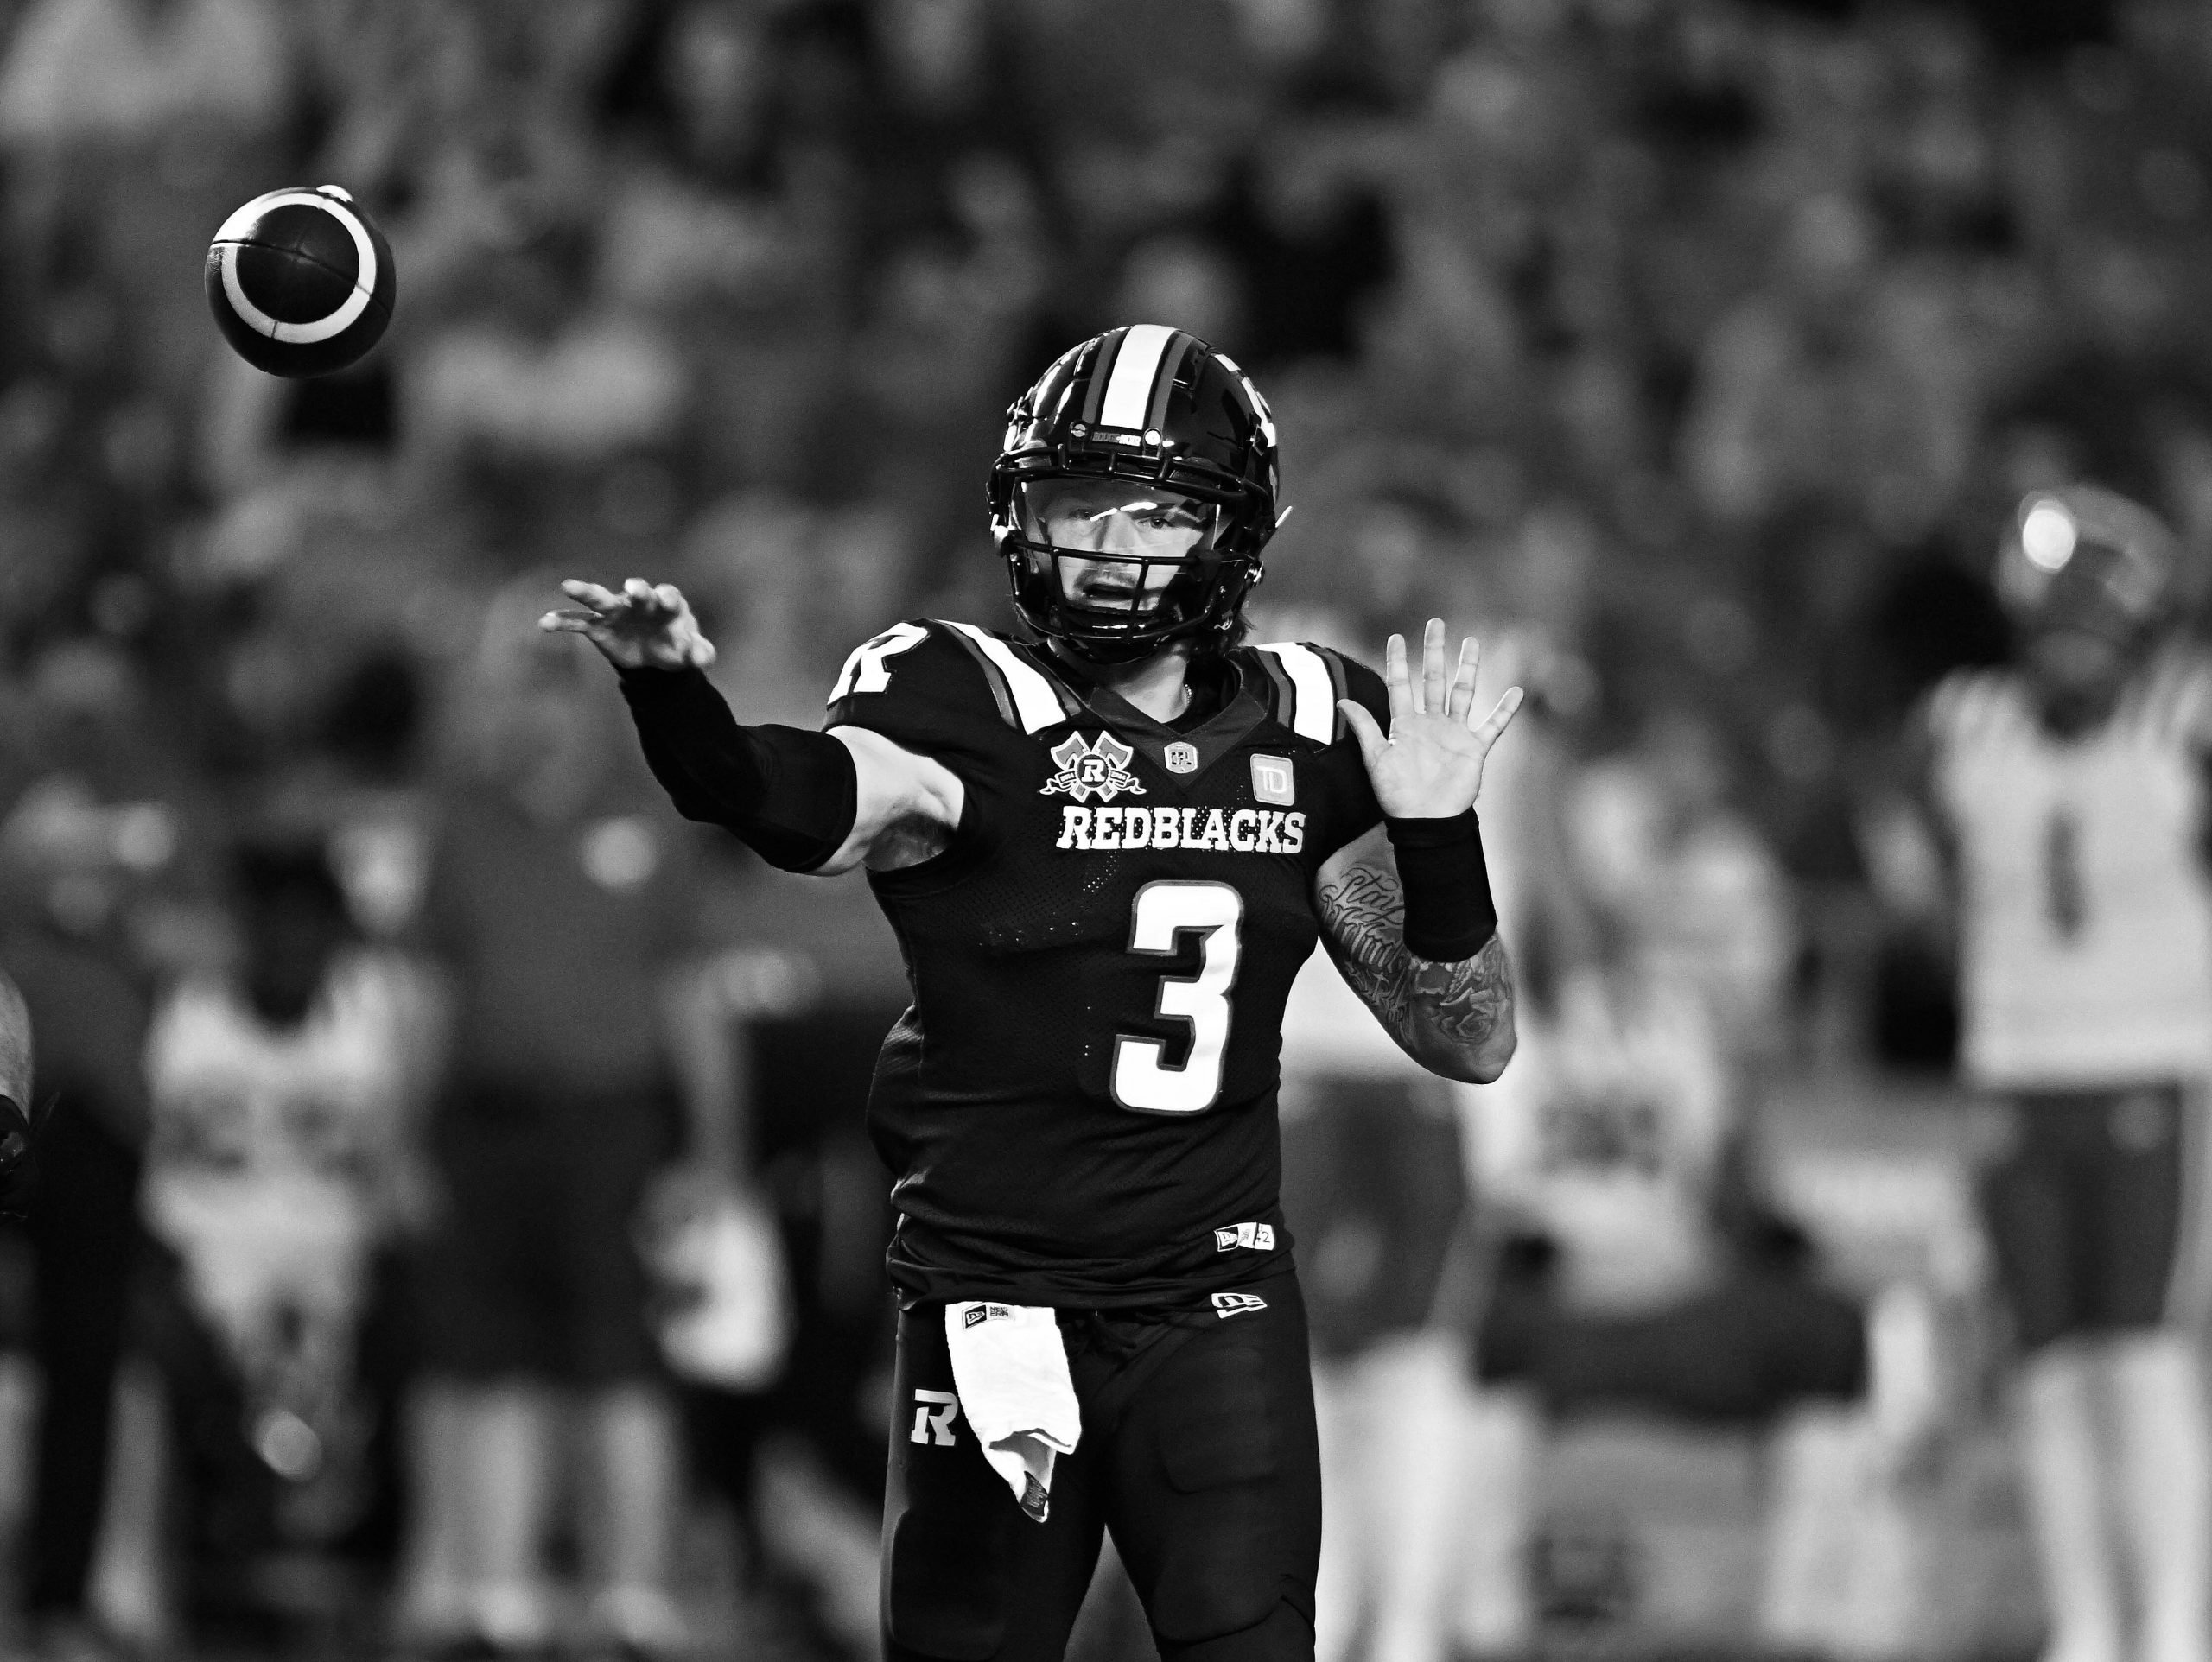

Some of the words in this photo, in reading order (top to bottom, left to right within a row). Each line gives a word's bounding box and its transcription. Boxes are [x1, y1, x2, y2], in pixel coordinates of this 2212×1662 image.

[826, 622, 928, 706] R
[1081, 759, 1105, 782] R
[1255, 765, 1287, 794] TD
[1056, 805, 1306, 853] REDBLACKS
[1109, 879, 1244, 1118] 3
[910, 1388, 959, 1447] R
